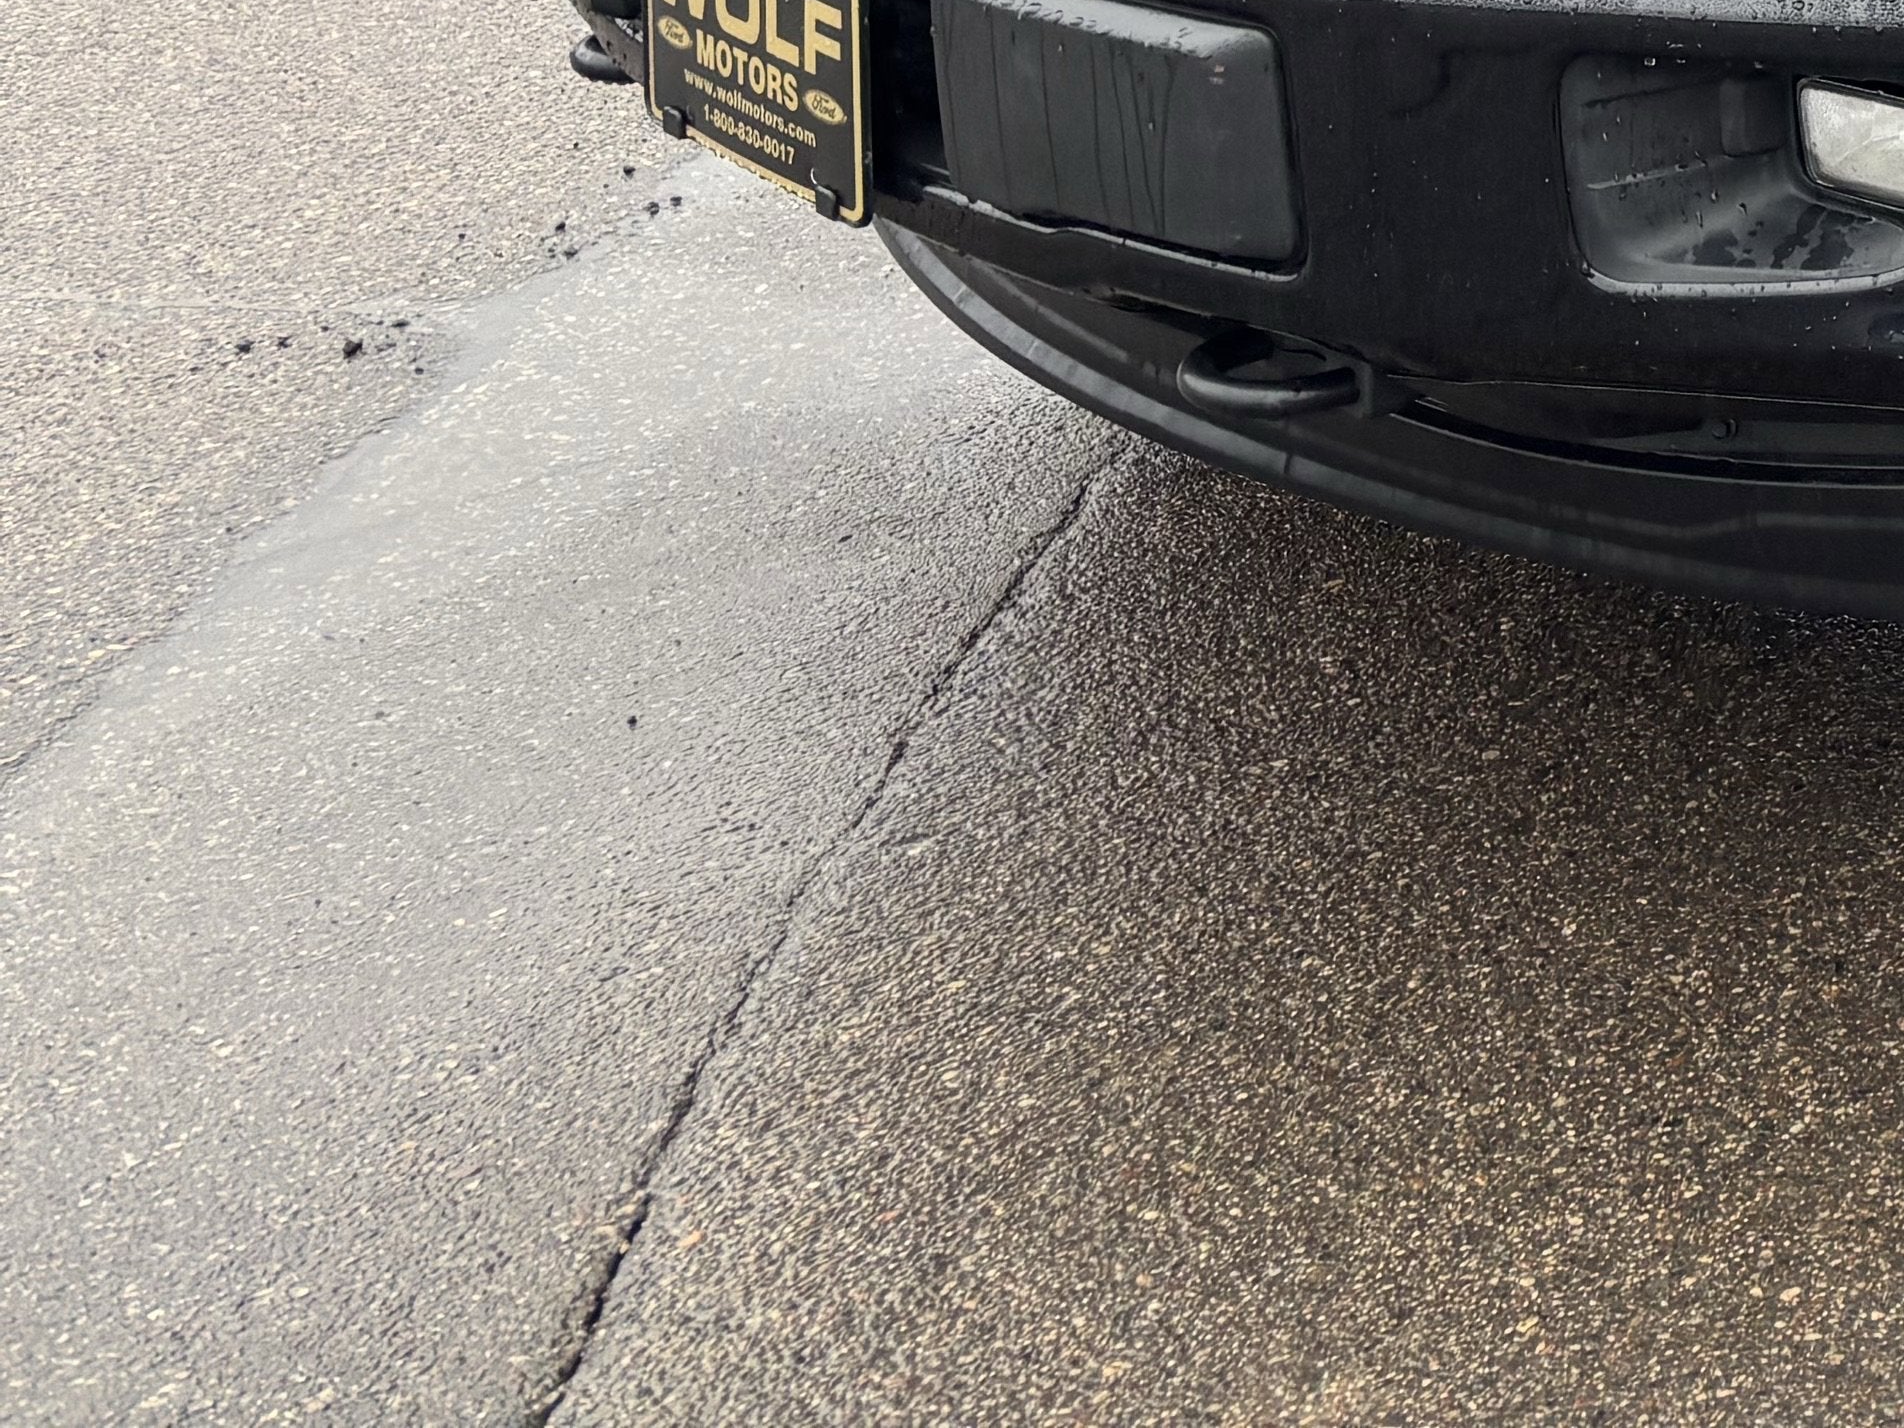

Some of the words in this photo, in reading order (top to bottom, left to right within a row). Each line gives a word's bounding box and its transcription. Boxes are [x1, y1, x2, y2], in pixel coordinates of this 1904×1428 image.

[683, 68, 818, 148] www.wolfmotors.com
[695, 28, 799, 113] MOTORS
[703, 103, 796, 165] 1-800-830-0017
